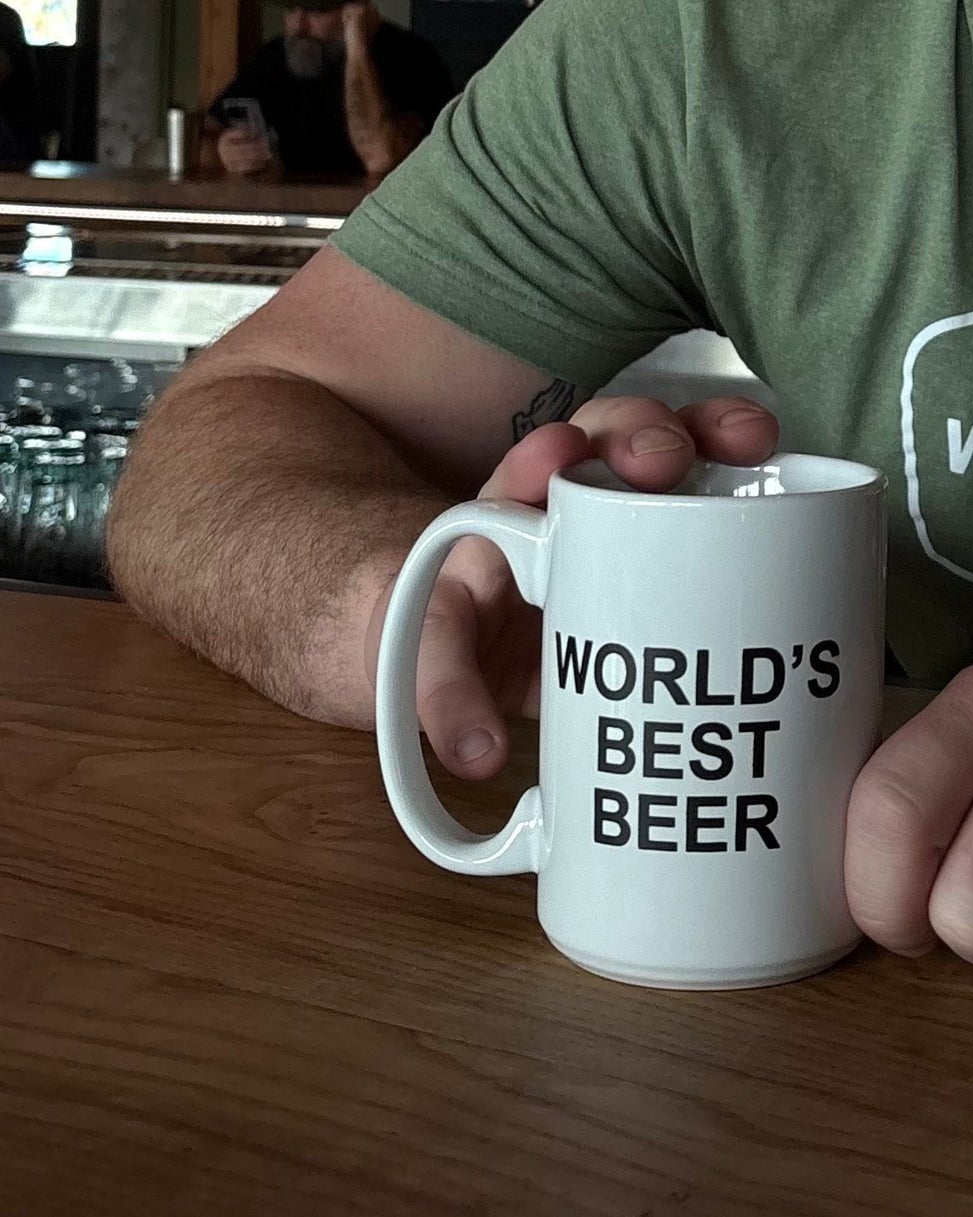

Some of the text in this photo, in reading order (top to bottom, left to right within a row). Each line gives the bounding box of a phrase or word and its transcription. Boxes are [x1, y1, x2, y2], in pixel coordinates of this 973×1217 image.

[555, 630, 842, 707] WORLD'S
[597, 715, 781, 782] BEST
[593, 787, 781, 853] BEER
